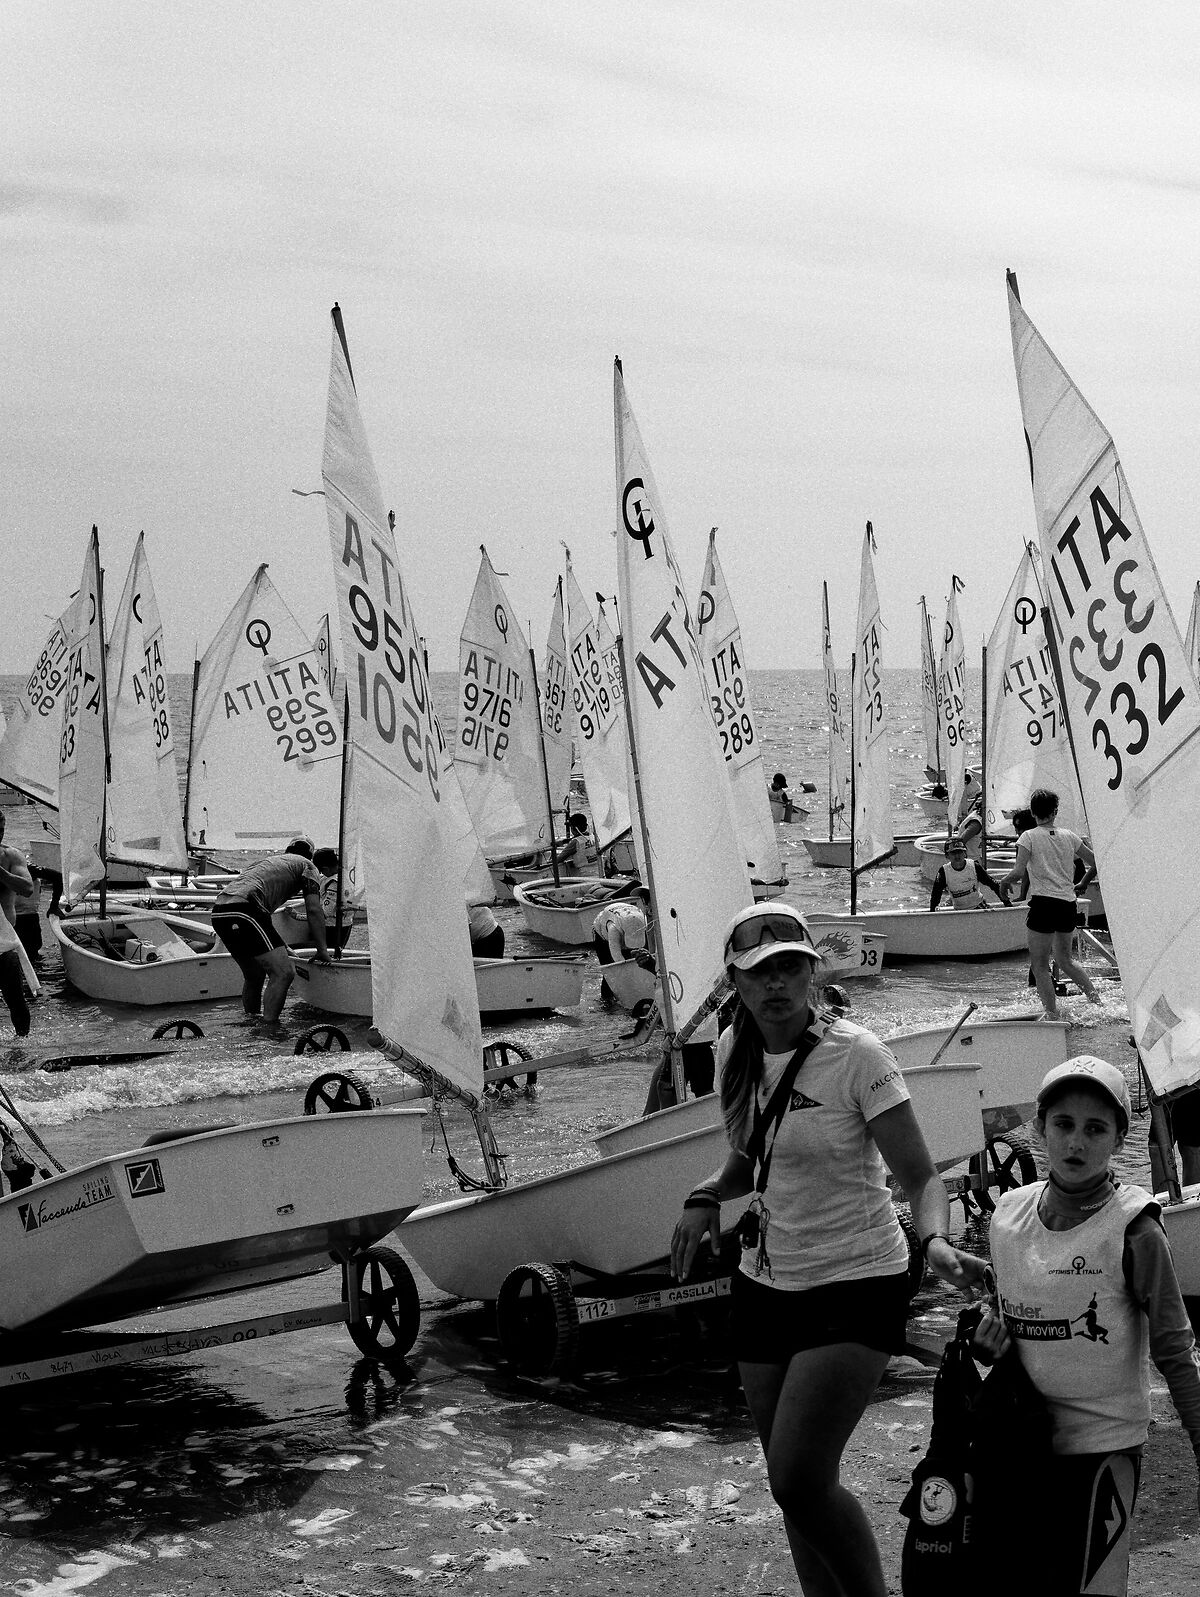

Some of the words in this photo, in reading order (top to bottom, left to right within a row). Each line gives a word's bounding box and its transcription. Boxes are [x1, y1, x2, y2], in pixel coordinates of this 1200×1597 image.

[1051, 485, 1133, 620] ITA
[711, 641, 741, 688] ITA
[463, 682, 512, 728] 9716
[1092, 642, 1186, 791] 332
[276, 720, 337, 763] 299
[82, 1175, 109, 1191] SAILING
[85, 1184, 114, 1204] TEAM
[668, 1285, 715, 1302] CASELLA
[585, 1301, 609, 1320] 112
[1026, 1322, 1066, 1337] moving
